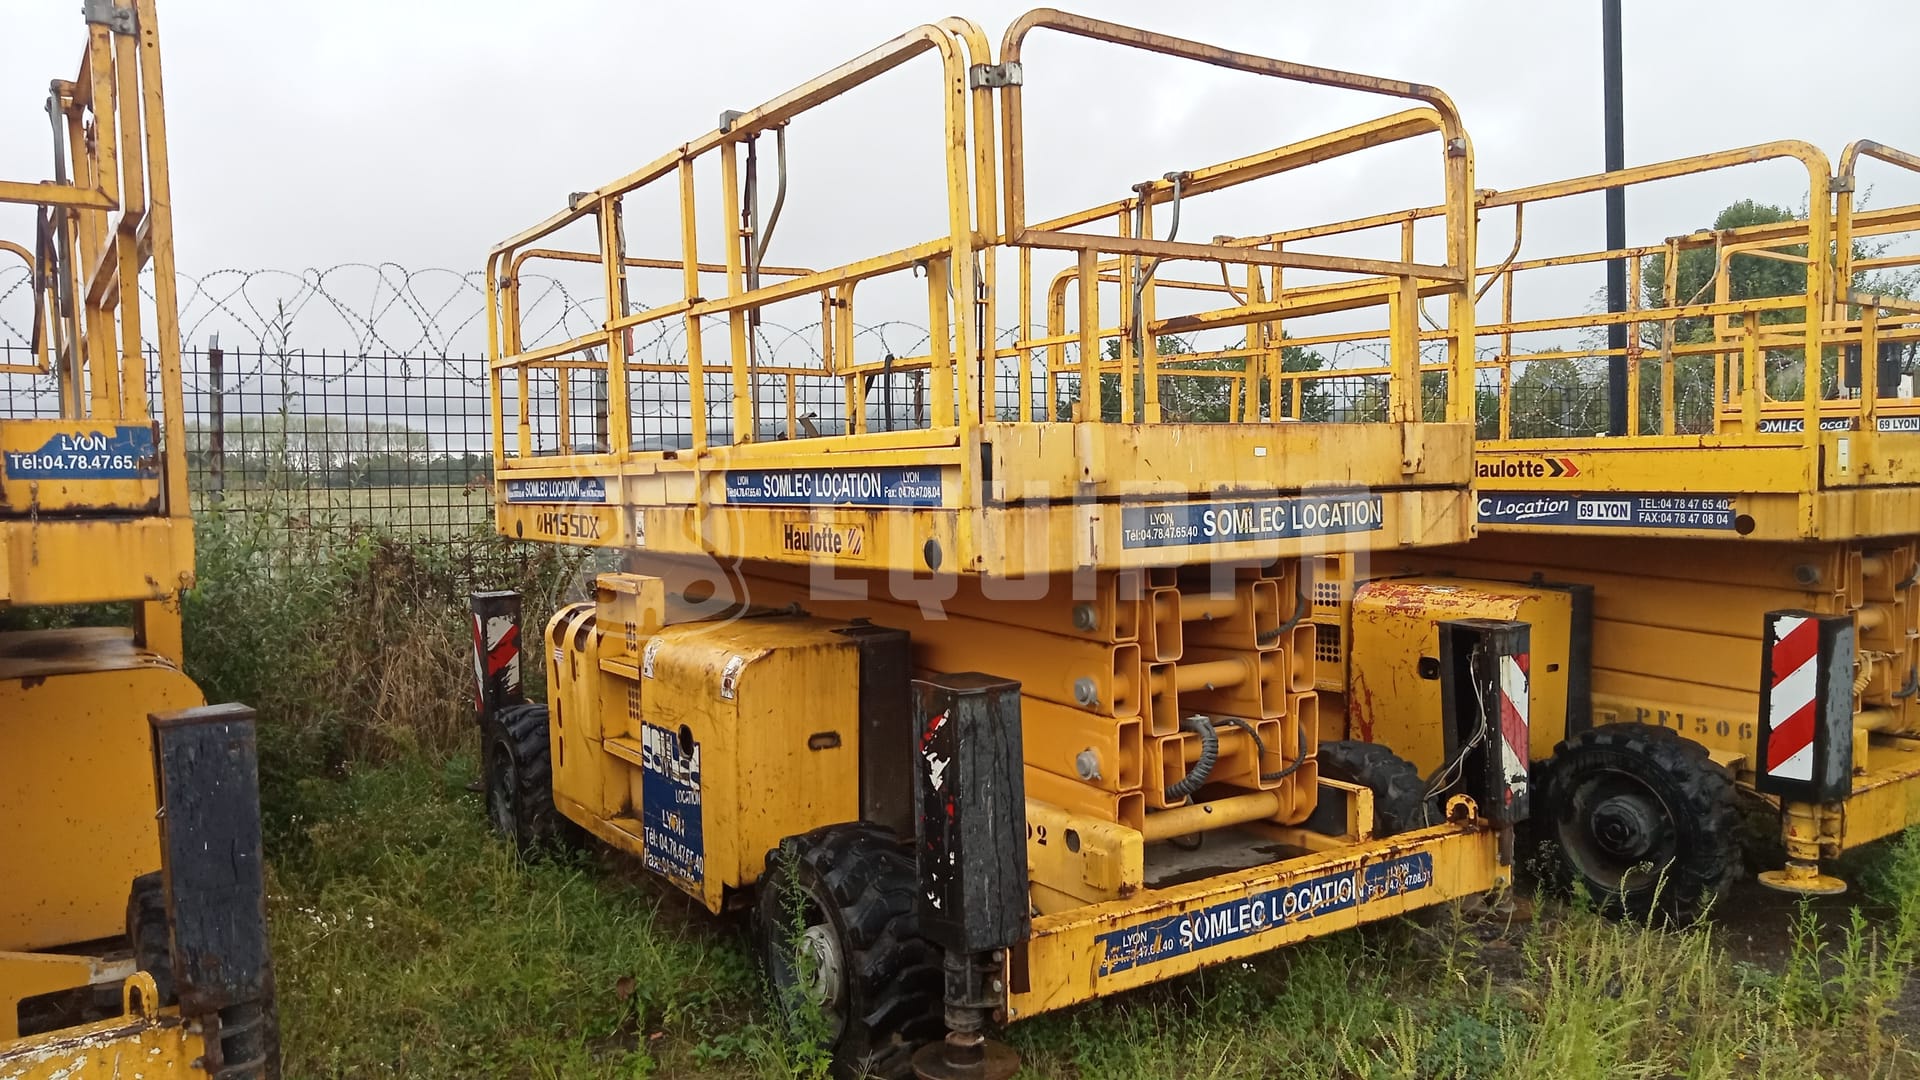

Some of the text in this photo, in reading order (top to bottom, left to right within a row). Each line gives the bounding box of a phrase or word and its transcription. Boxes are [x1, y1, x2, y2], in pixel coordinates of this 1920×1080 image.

[1879, 418, 1918, 430] 69 LYON
[61, 435, 107, 451] LYON
[10, 453, 153, 471] Tél:04.78.47.65.
[737, 475, 749, 486] LYON
[763, 472, 882, 499] SOMLEC LOCATION
[902, 471, 920, 484] LYON
[524, 479, 548, 498] SOMLEC
[549, 479, 580, 498] LOCATION
[884, 485, 941, 499] Fax: 04.78.47.08.04
[1495, 497, 1569, 516] Location
[1580, 502, 1628, 520] 69 LYON
[1639, 498, 1728, 511] TEL:04 78 47 65 40
[1150, 512, 1175, 526] LYON
[1203, 499, 1382, 537] SOMLEC LOCATION
[1638, 512, 1728, 525] FAX:04 78 47 08 04
[783, 524, 842, 554] Haulotte
[1124, 525, 1199, 542] Tél:04.78.47.65.40
[675, 789, 701, 806] LOCATION
[644, 826, 659, 848] Tél:
[1179, 873, 1365, 947] SOMLEC LOCATION
[1122, 930, 1148, 948] LYON
